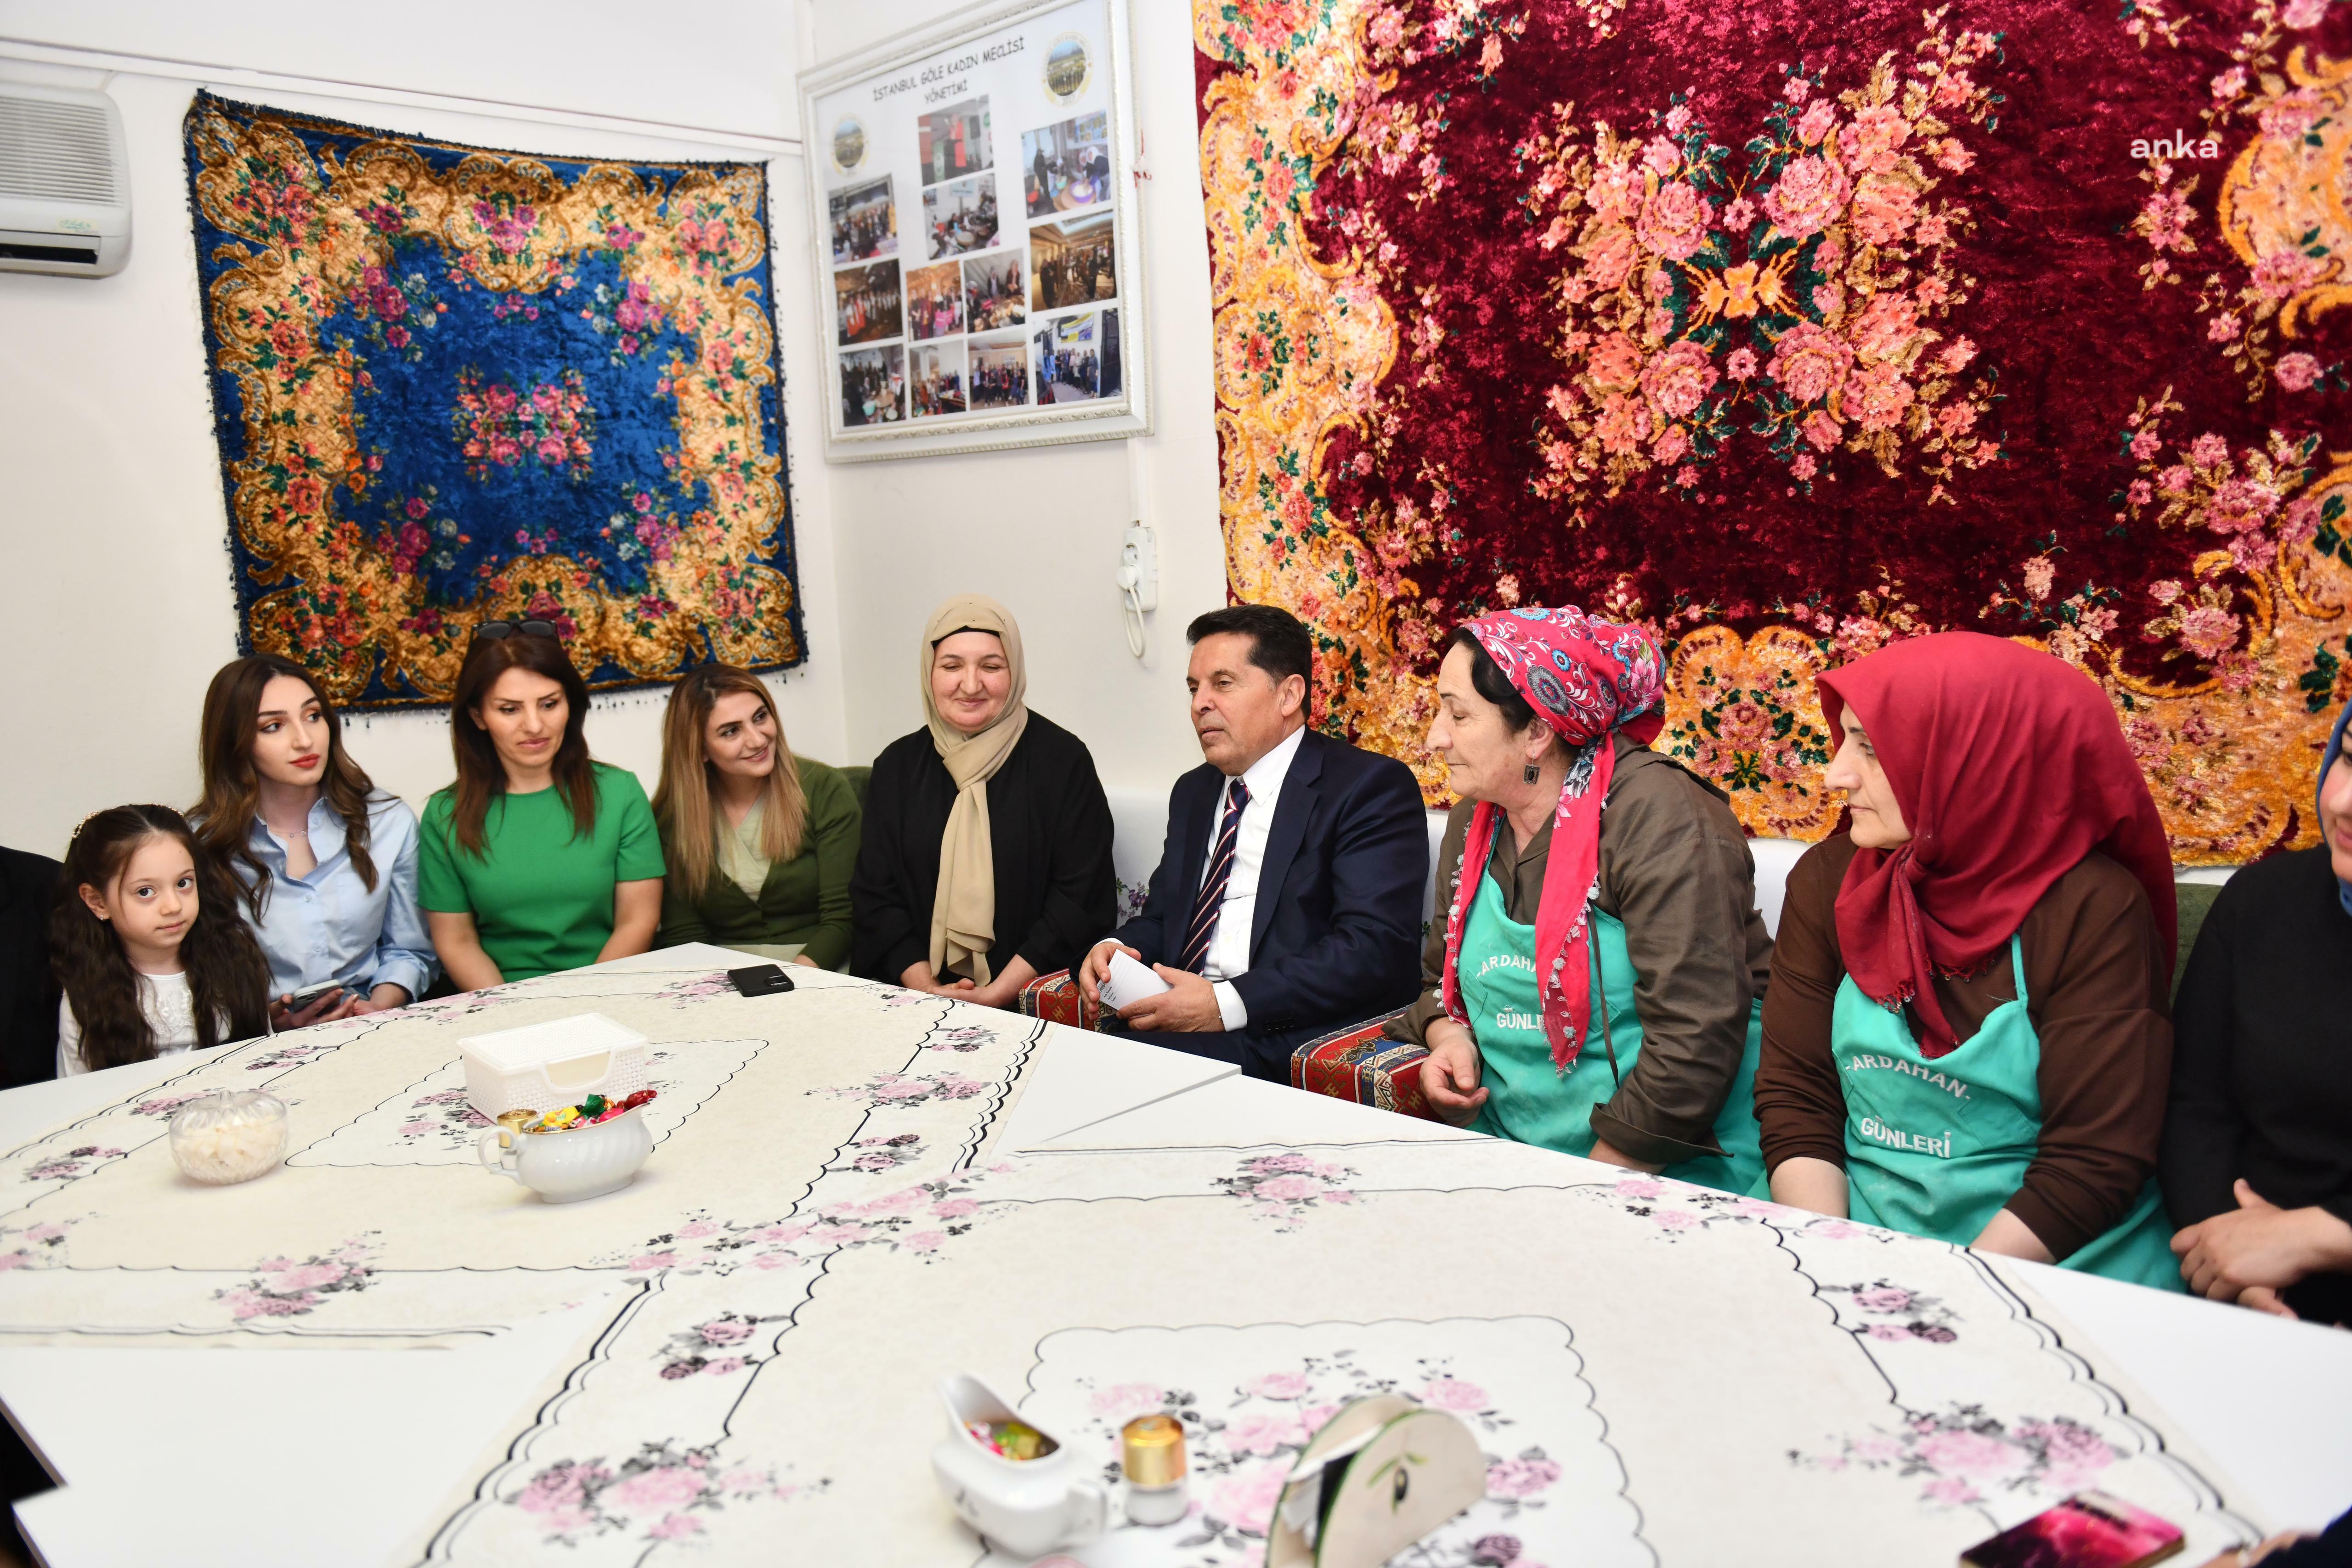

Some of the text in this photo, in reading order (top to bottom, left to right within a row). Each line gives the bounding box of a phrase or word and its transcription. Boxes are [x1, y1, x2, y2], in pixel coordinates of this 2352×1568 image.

[873, 76, 917, 102] İSTANBUL
[921, 65, 944, 85] GÖLE
[947, 53, 978, 75] KADIN
[982, 35, 1025, 64] MECLİSİ
[924, 77, 968, 104] YÖNETİMİ
[1860, 1115, 1951, 1158] GÜNLERİ
